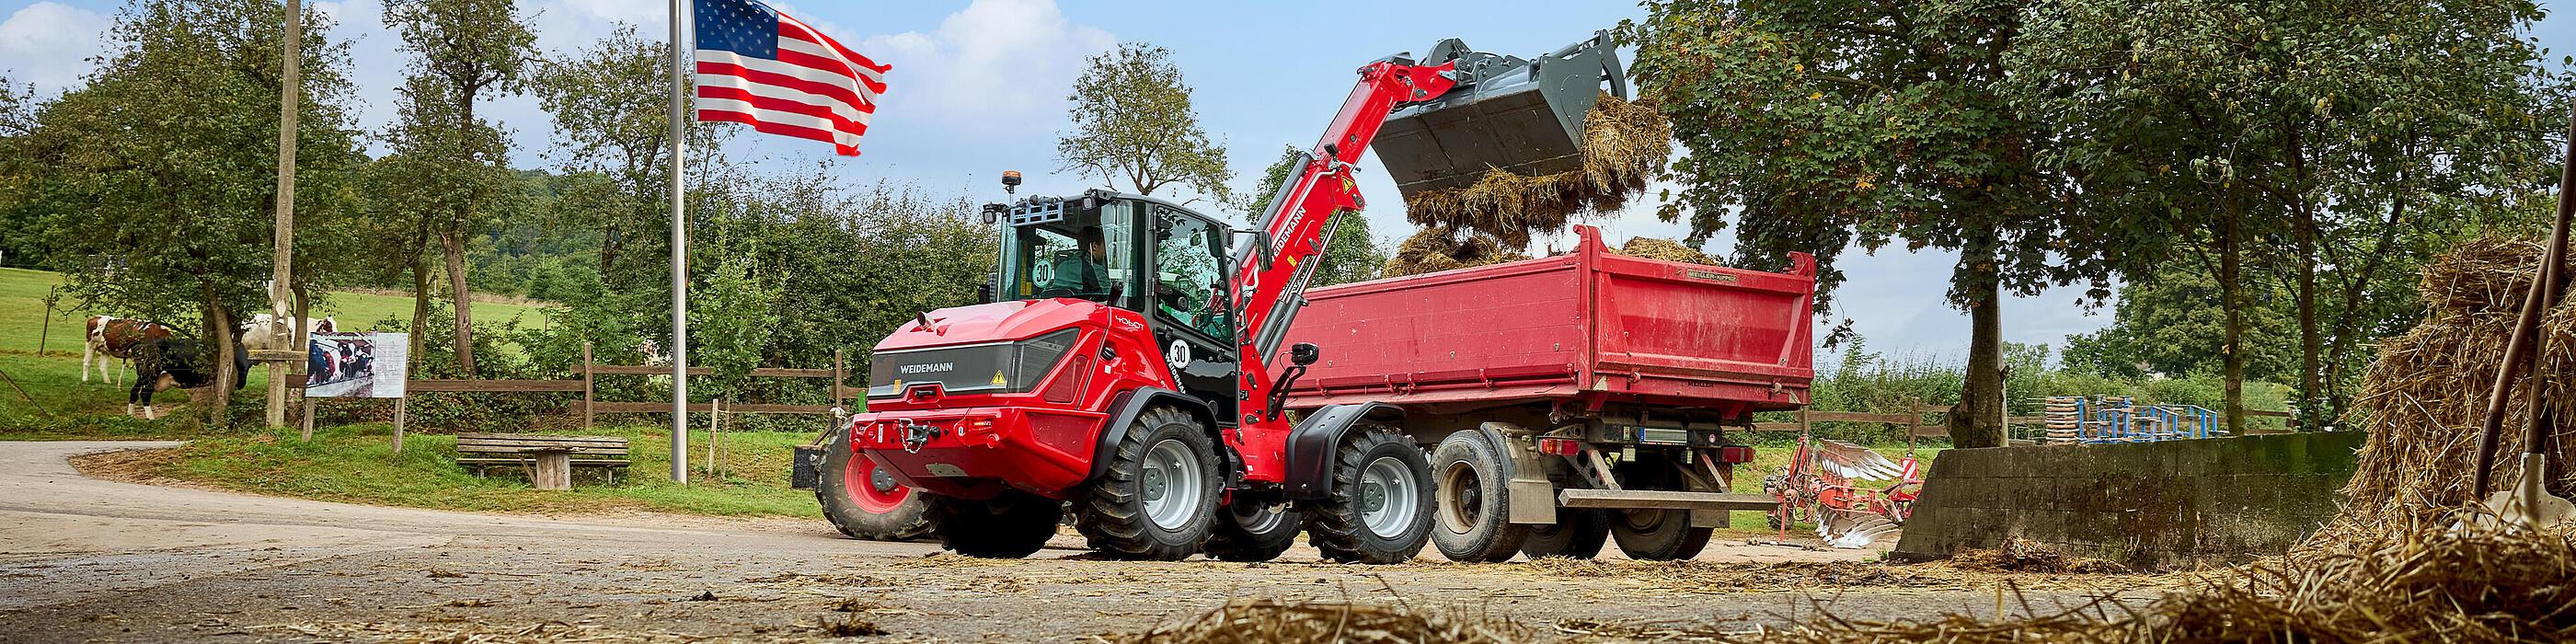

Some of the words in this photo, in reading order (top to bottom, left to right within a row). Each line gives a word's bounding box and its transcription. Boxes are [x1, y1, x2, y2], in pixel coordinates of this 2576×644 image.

[1271, 206, 1306, 262] EIDEMANN
[1037, 264, 1048, 282] 30
[1174, 345, 1186, 362] 30
[901, 362, 953, 374] WEIDEMANN
